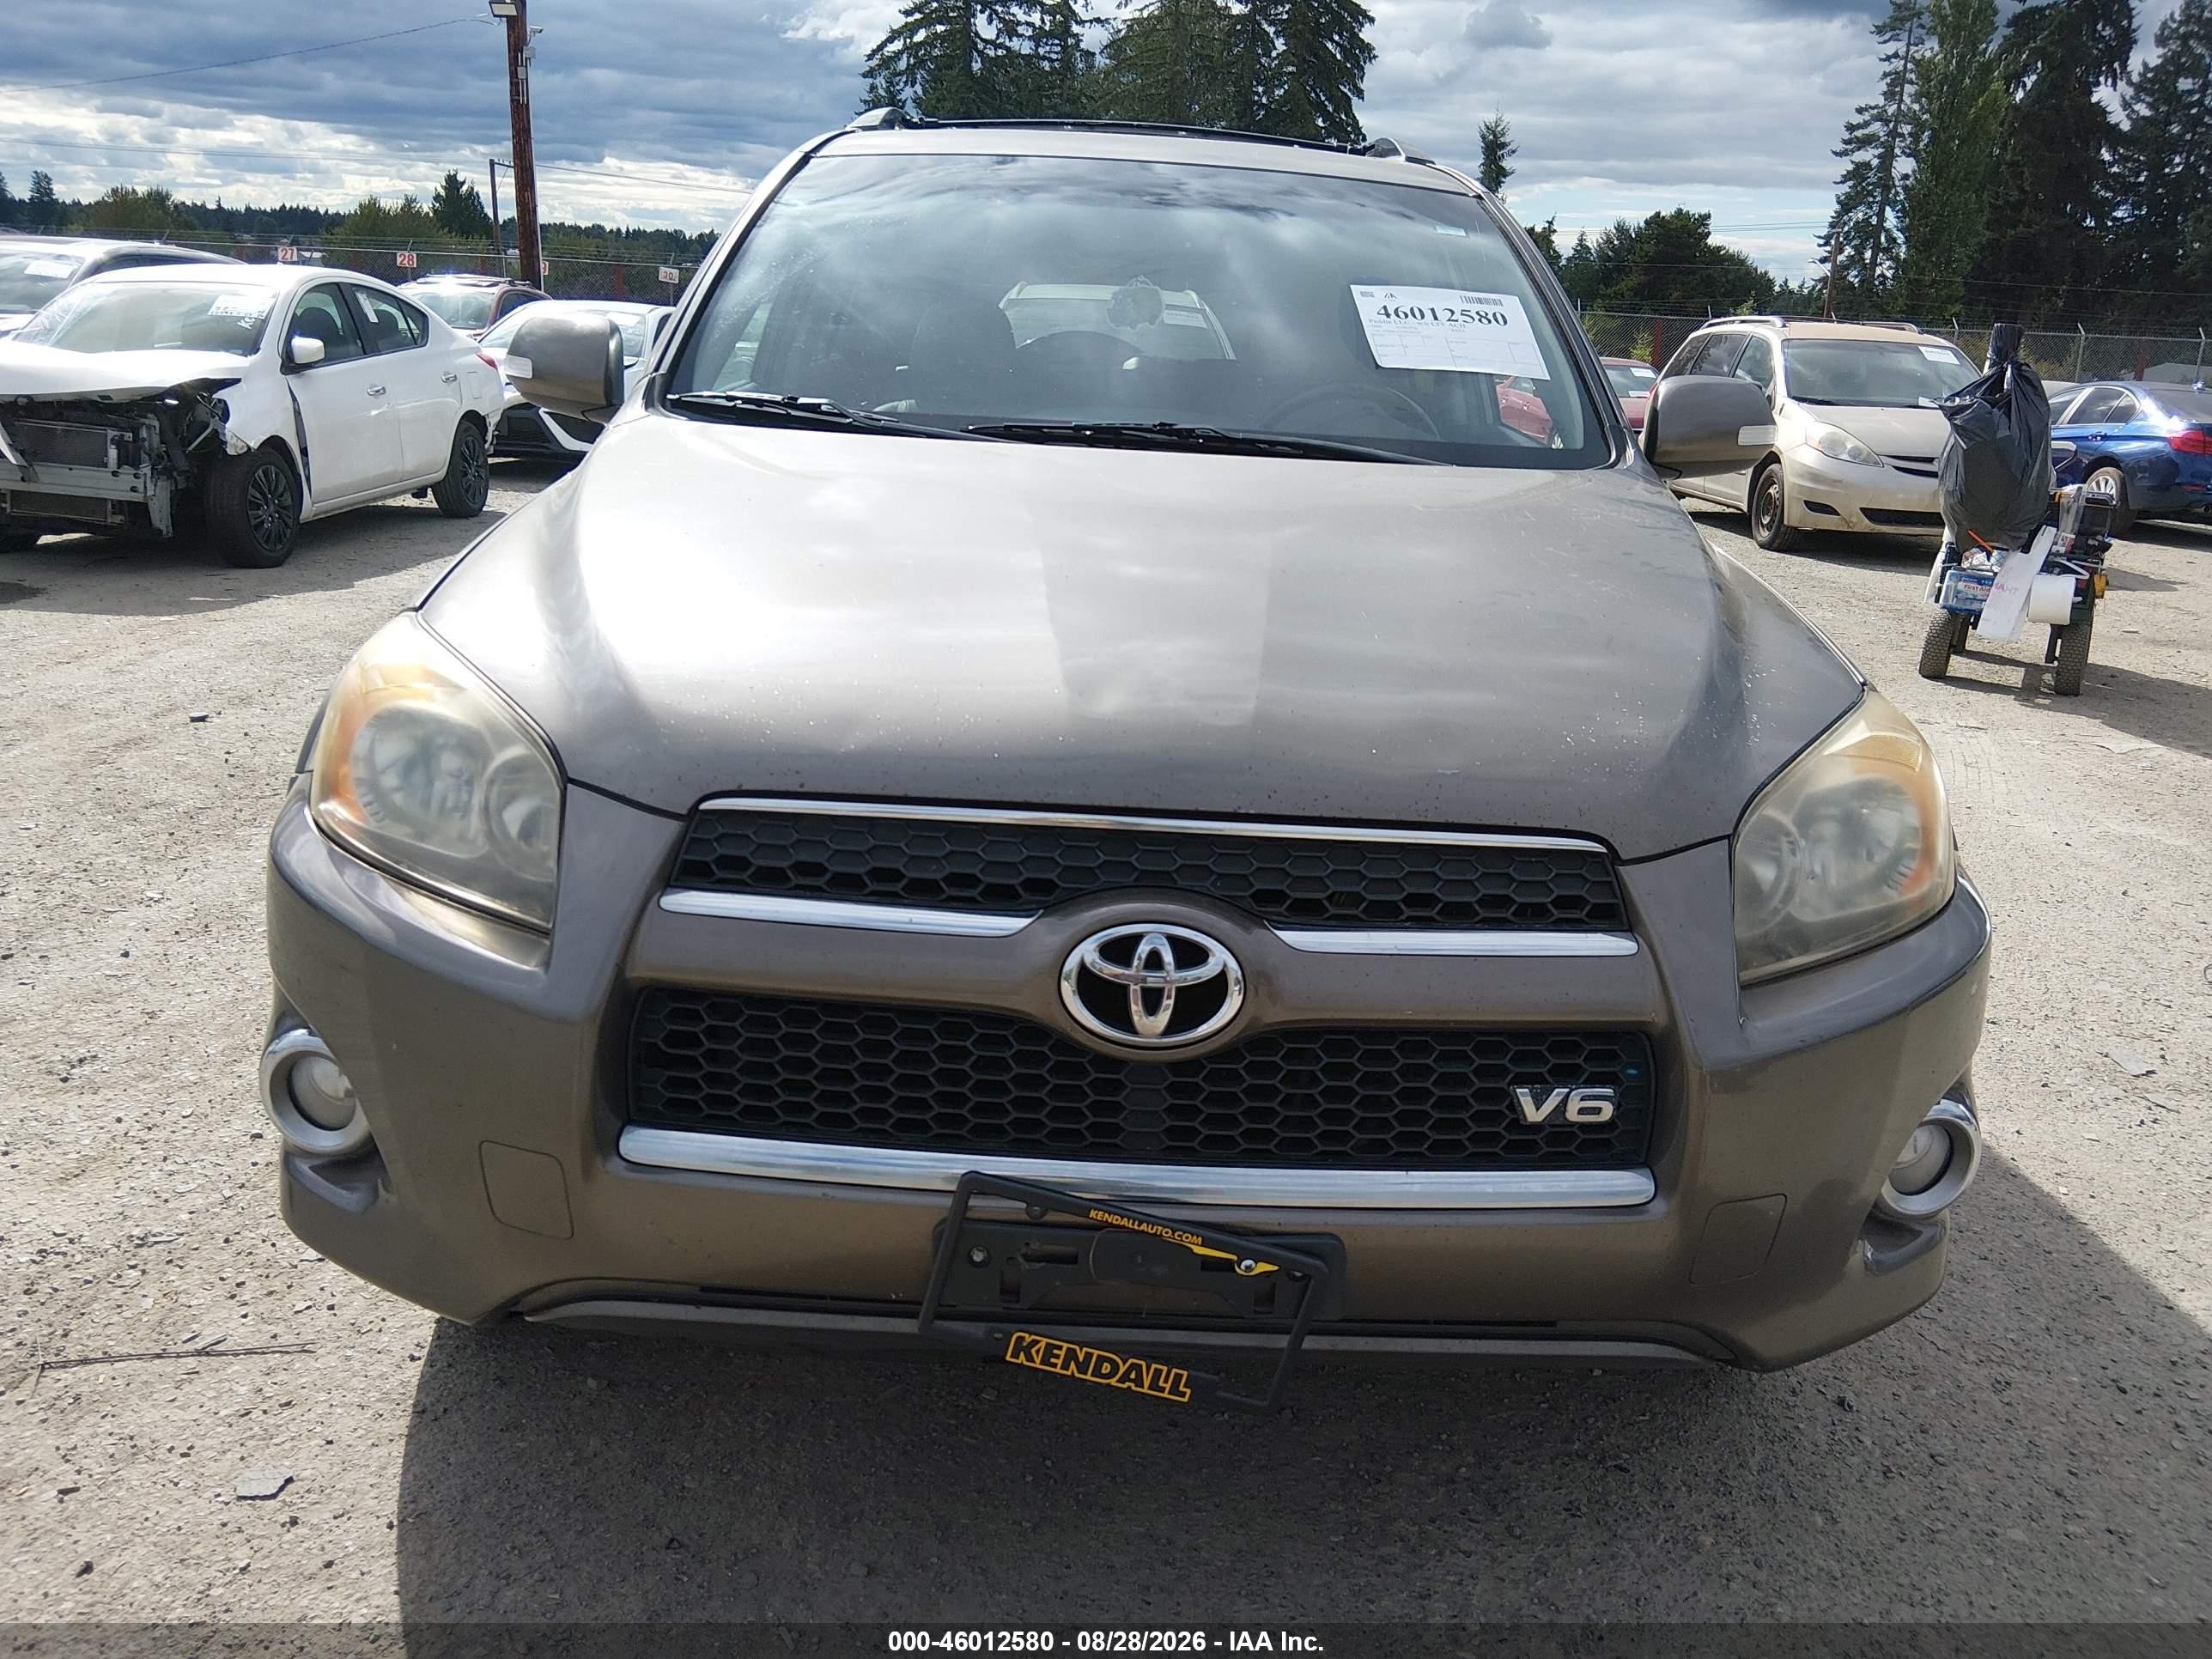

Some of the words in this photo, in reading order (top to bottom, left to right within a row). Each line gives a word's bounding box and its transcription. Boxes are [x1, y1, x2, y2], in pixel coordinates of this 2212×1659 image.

[281, 247, 294, 260] 27
[398, 253, 415, 265] 28
[663, 270, 674, 280] 30
[1376, 304, 1508, 327] 46012580
[1515, 1087, 1614, 1122] V6
[1089, 1207, 1202, 1245] KENDALLAUTO.COM
[1006, 1331, 1192, 1403] KENDALL
